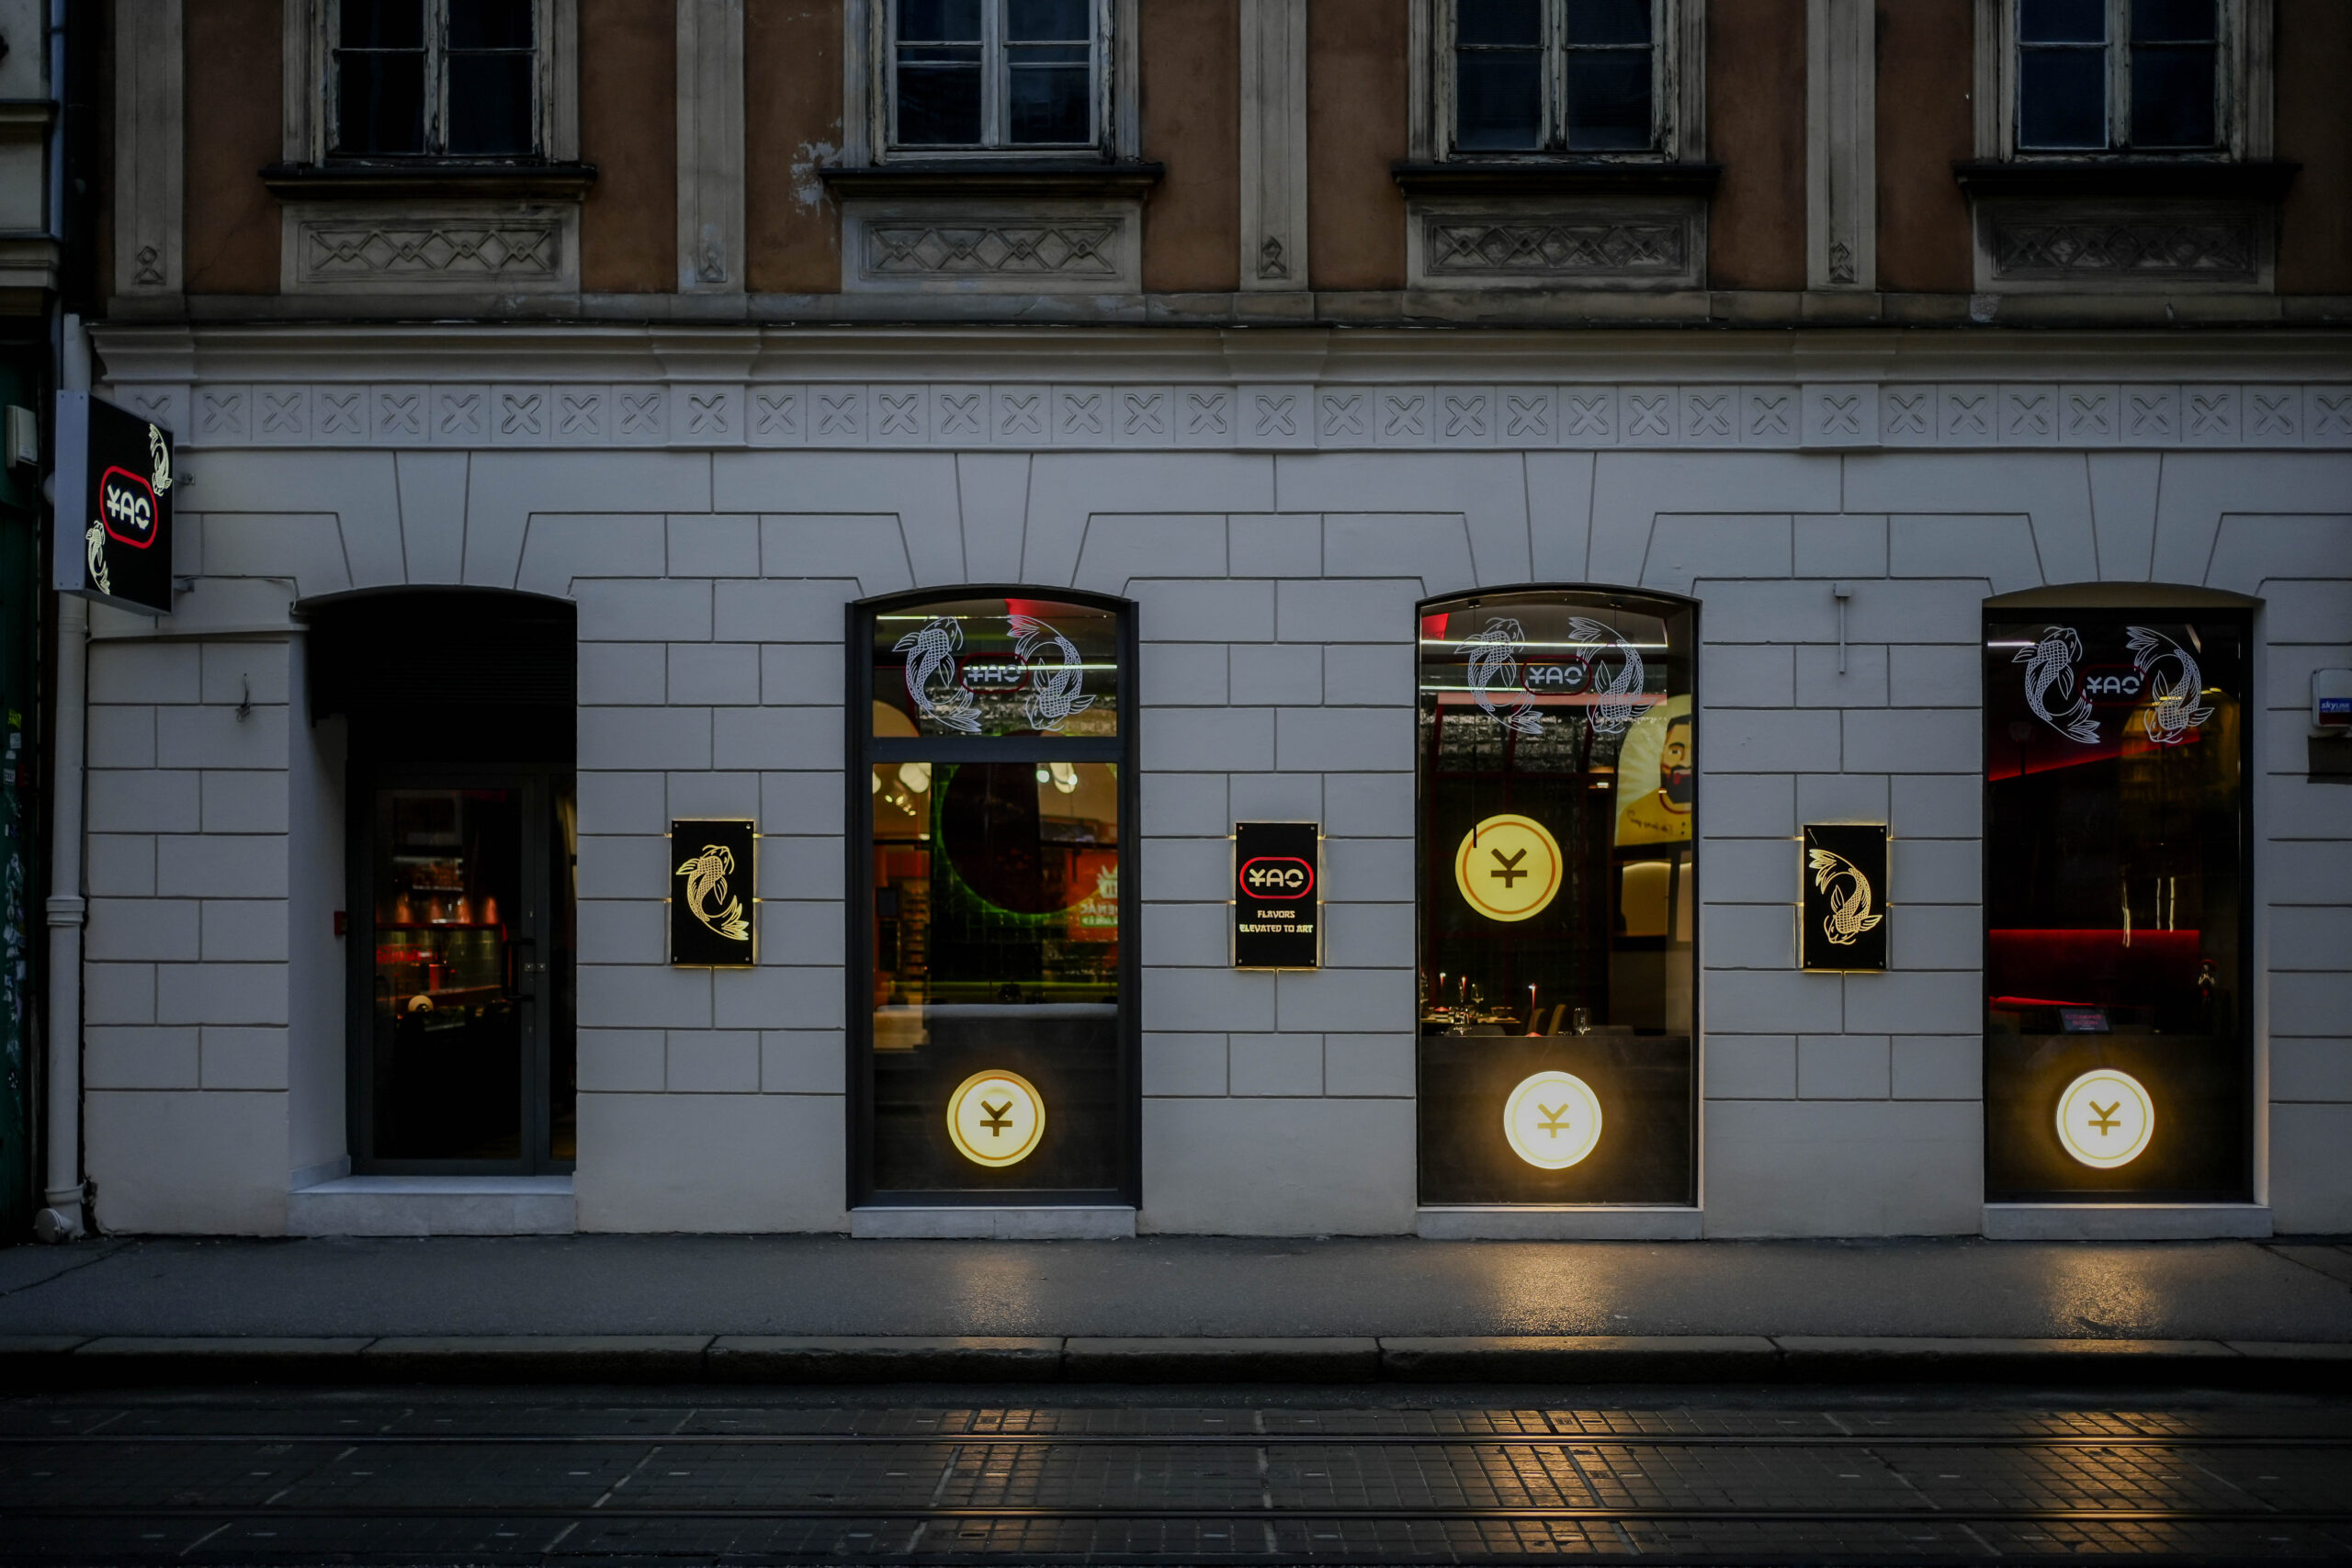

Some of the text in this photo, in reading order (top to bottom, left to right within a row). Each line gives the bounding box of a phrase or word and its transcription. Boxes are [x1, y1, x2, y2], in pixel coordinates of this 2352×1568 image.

[1257, 910, 1295, 919] FLAVORS
[1238, 924, 1282, 933] ELEVATED
[1296, 924, 1314, 933] ART
